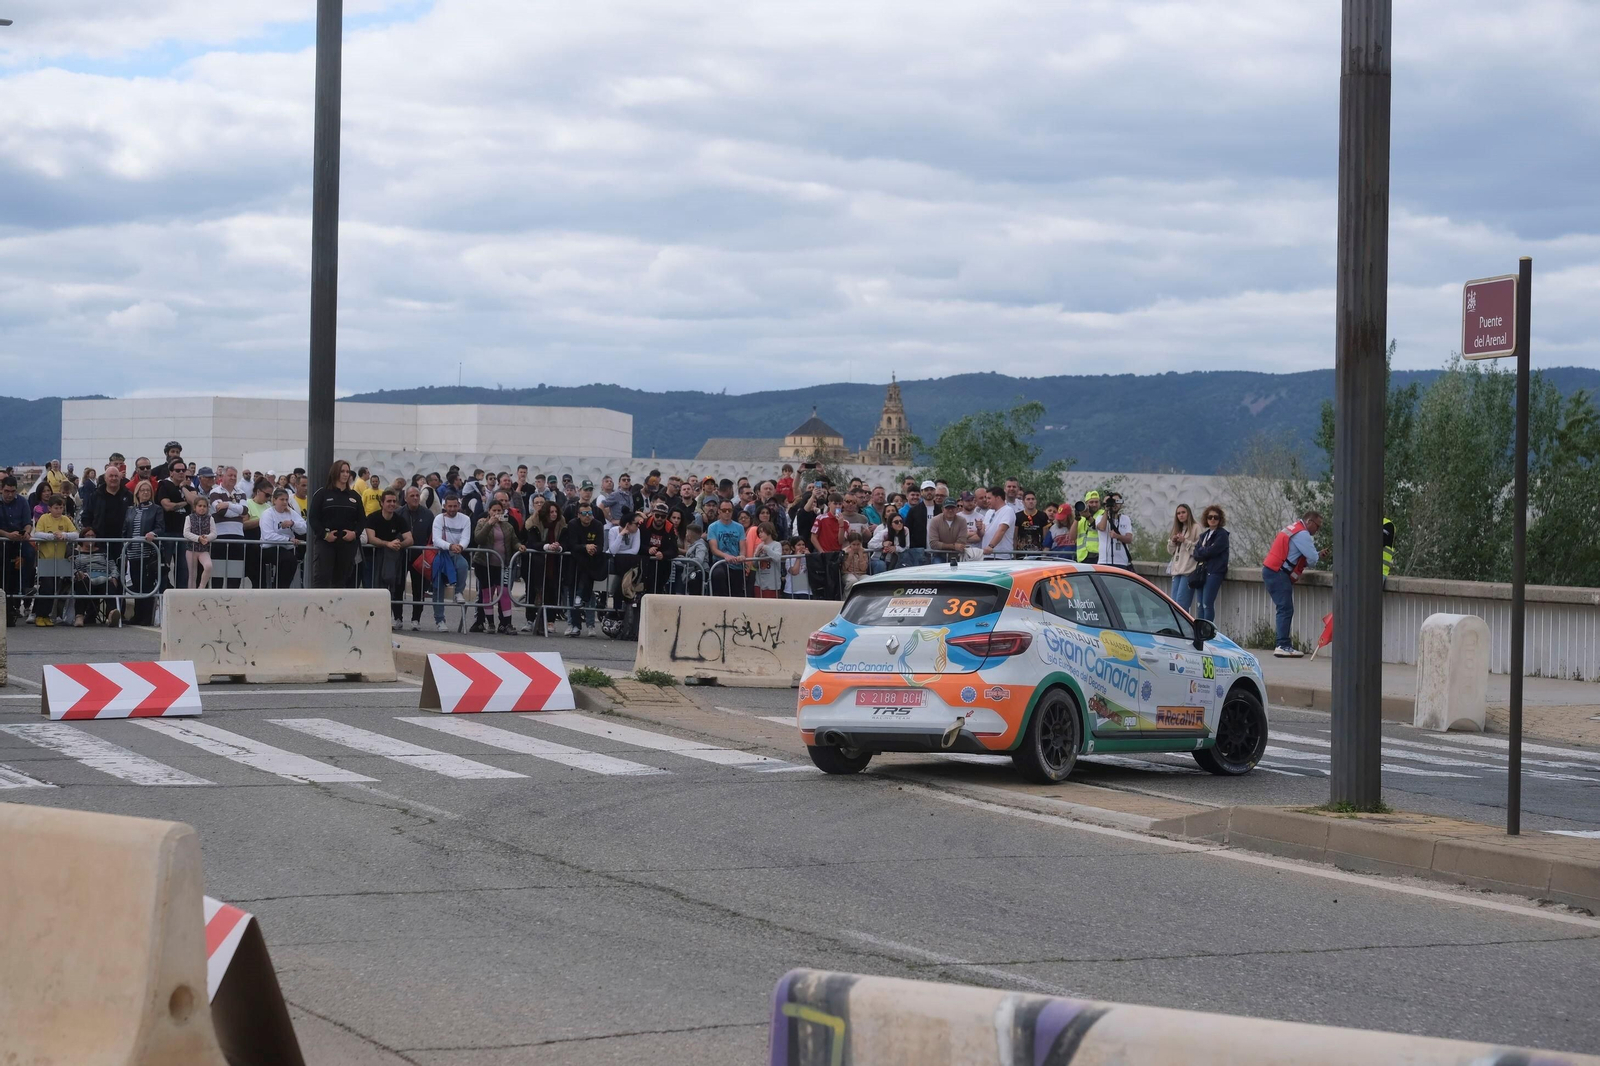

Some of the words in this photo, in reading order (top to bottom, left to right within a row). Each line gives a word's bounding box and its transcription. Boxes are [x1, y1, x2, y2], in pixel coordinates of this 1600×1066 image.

[1479, 316, 1502, 328] Puente
[1474, 335, 1485, 347] del
[1485, 332, 1507, 346] Arenal
[1042, 569, 1074, 600] 36
[942, 598, 978, 617] 36
[1055, 627, 1100, 649] RENAULT
[836, 661, 857, 671] Gran
[857, 661, 894, 671] Canaria
[1043, 628, 1083, 667] Gran
[1084, 646, 1139, 699] Canaria
[1202, 656, 1214, 679] 36
[1047, 652, 1058, 665] Isla
[1058, 659, 1080, 678] Europea
[1080, 671, 1088, 683] del
[1088, 676, 1107, 694] Deporte
[860, 692, 866, 703] S
[872, 692, 896, 703] 2188
[902, 692, 922, 703] BCH
[872, 707, 913, 715] TRS
[1164, 709, 1197, 726] Recalvi
